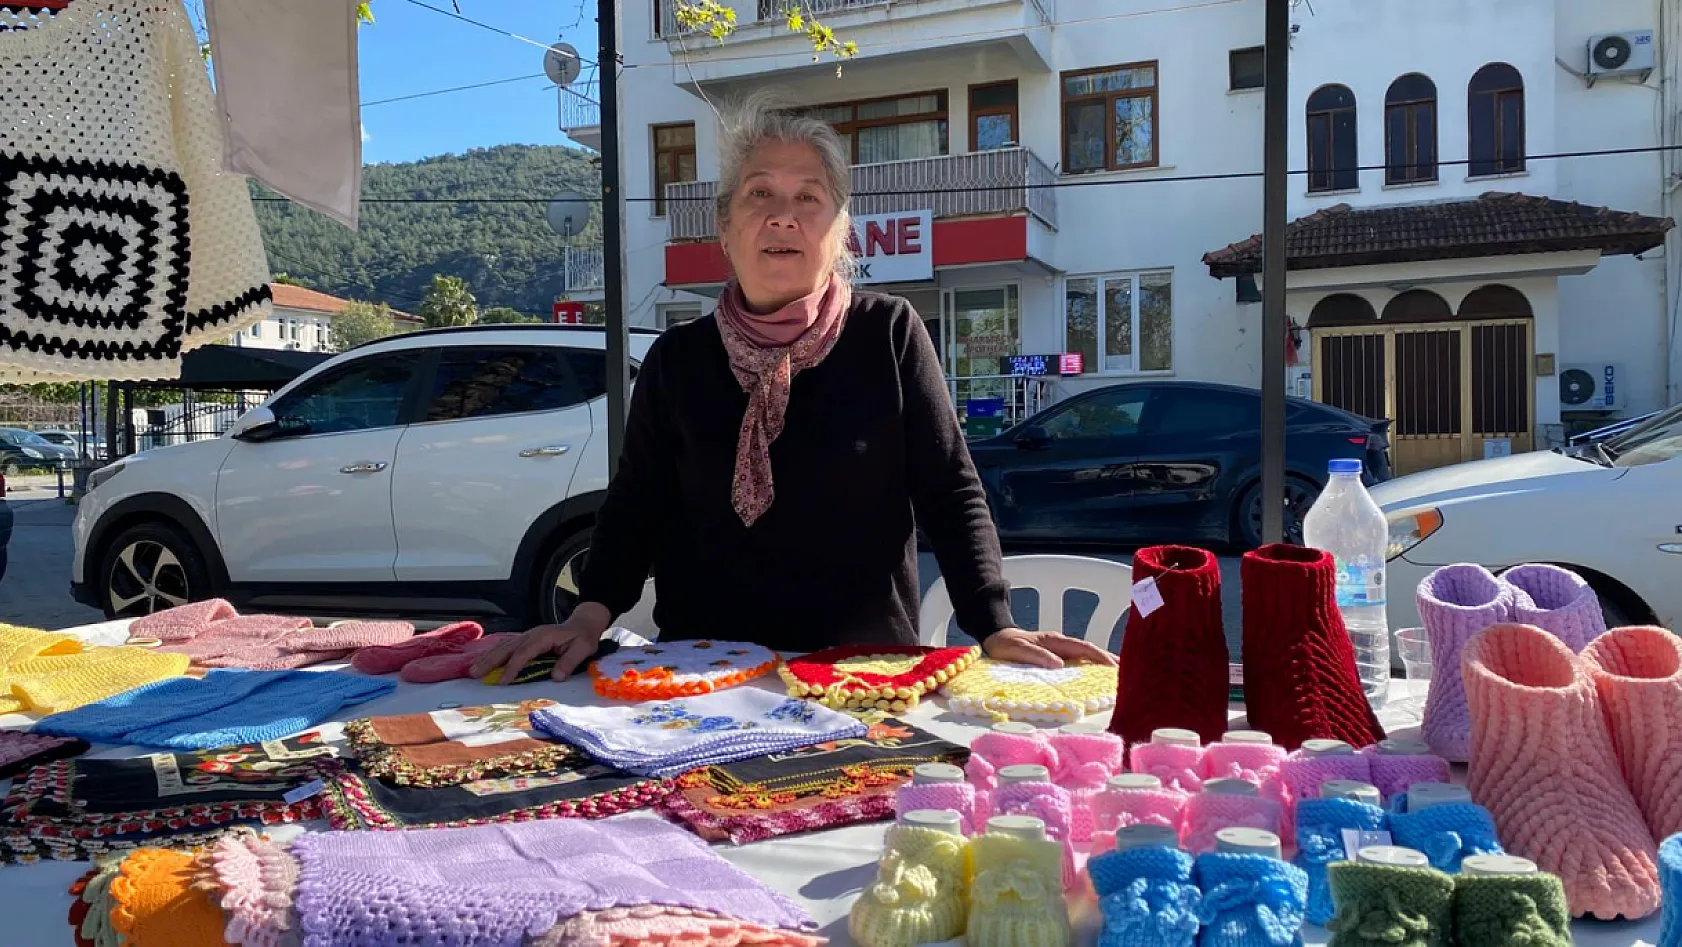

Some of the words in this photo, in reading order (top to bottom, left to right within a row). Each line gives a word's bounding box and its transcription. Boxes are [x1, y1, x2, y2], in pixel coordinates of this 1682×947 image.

[844, 217, 921, 258] ANE
[852, 264, 872, 278] RK
[1605, 366, 1614, 405] BEKO
